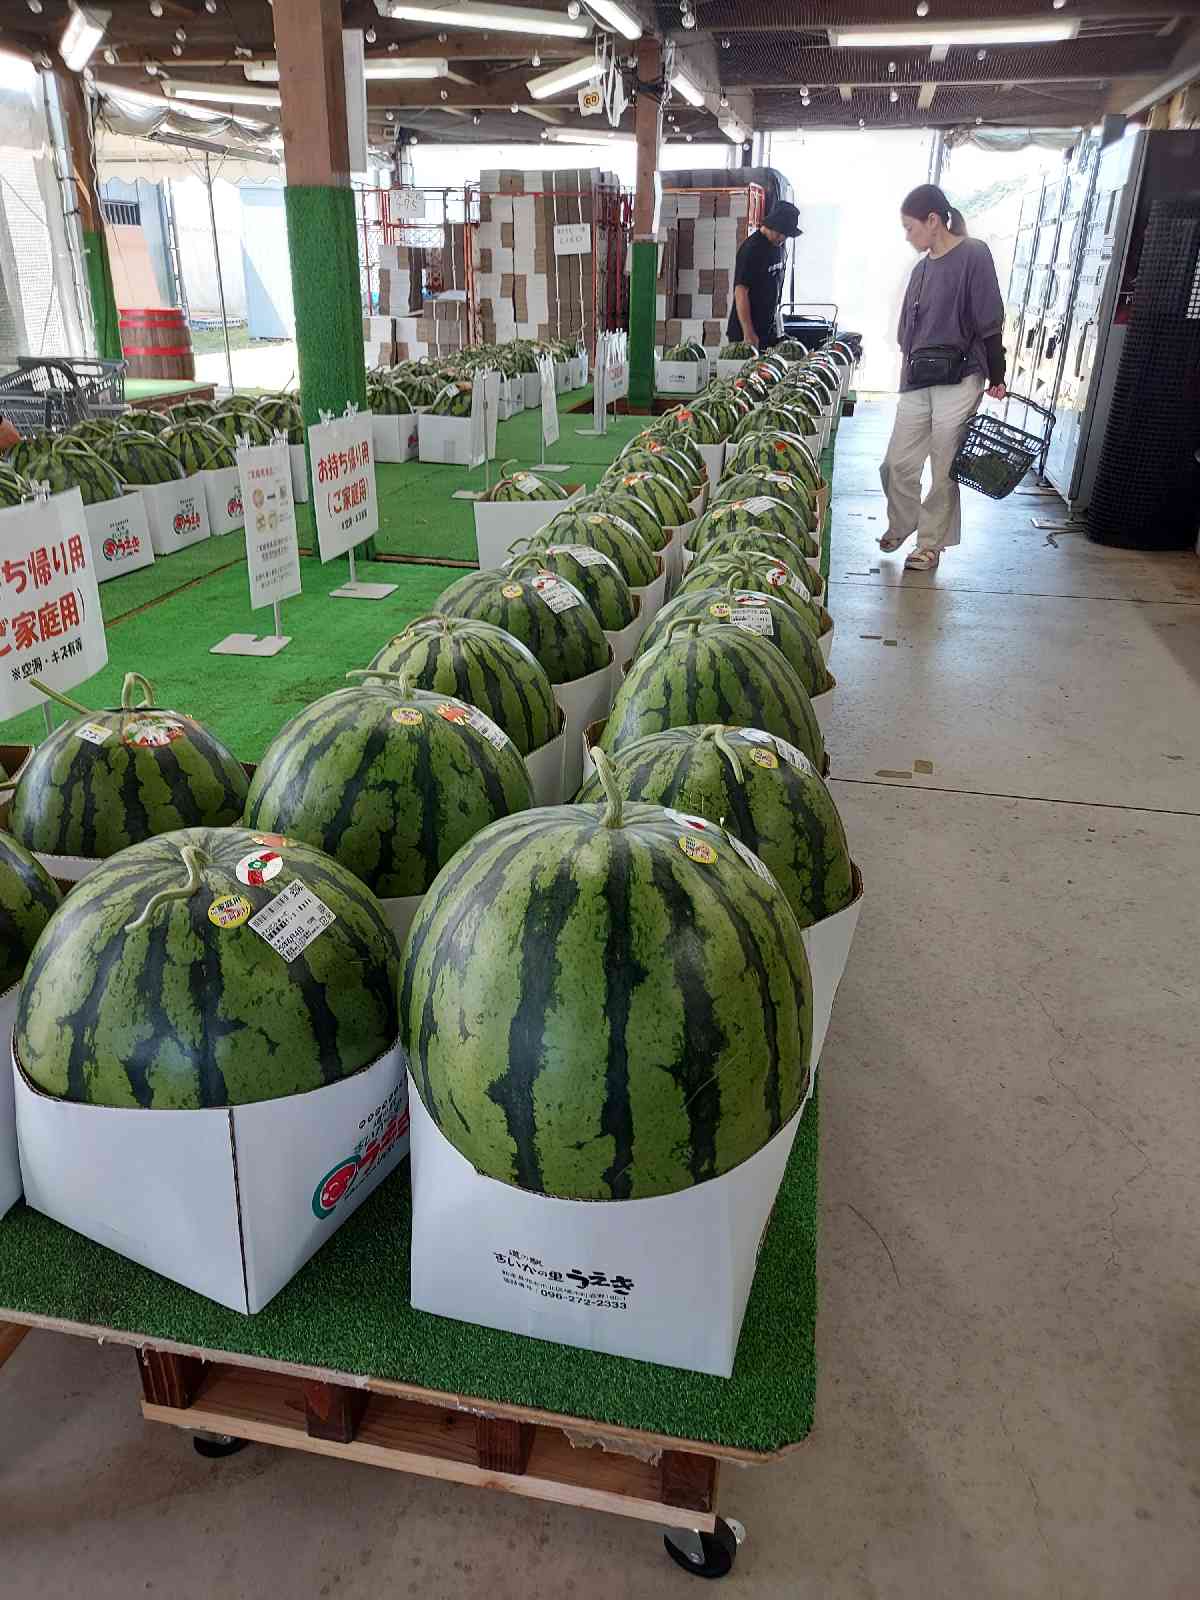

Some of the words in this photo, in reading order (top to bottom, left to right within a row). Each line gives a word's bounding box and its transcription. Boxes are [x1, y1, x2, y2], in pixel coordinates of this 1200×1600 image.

[317, 440, 370, 483] お持ち帰り用
[0, 533, 86, 594] ち帰り用
[565, 1268, 635, 1296] うえき
